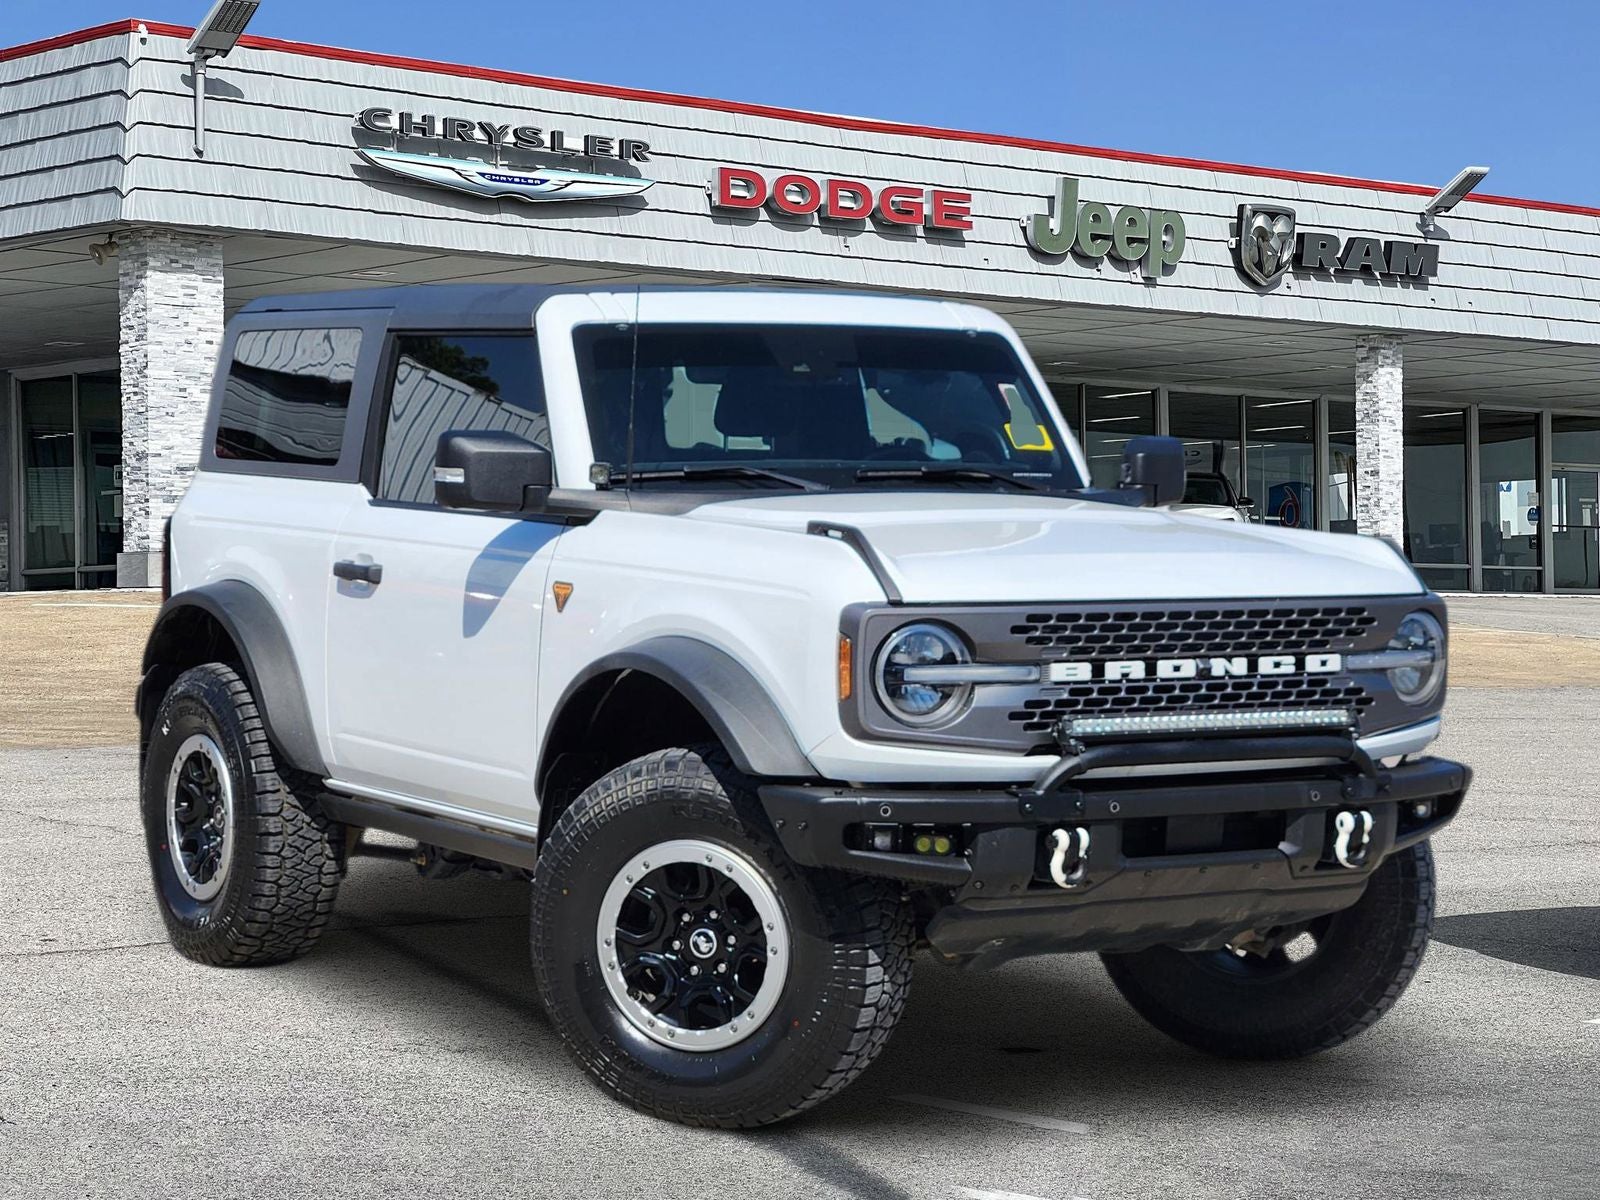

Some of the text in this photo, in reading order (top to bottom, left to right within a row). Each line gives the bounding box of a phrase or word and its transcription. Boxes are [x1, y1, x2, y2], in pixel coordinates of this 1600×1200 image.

[358, 107, 651, 162] CHRYSLER
[484, 174, 541, 185] CHRYSLER
[712, 167, 973, 231] DODGE
[1027, 177, 1186, 278] Jeep
[1301, 232, 1440, 277] RAM
[1050, 653, 1342, 682] BRONCO
